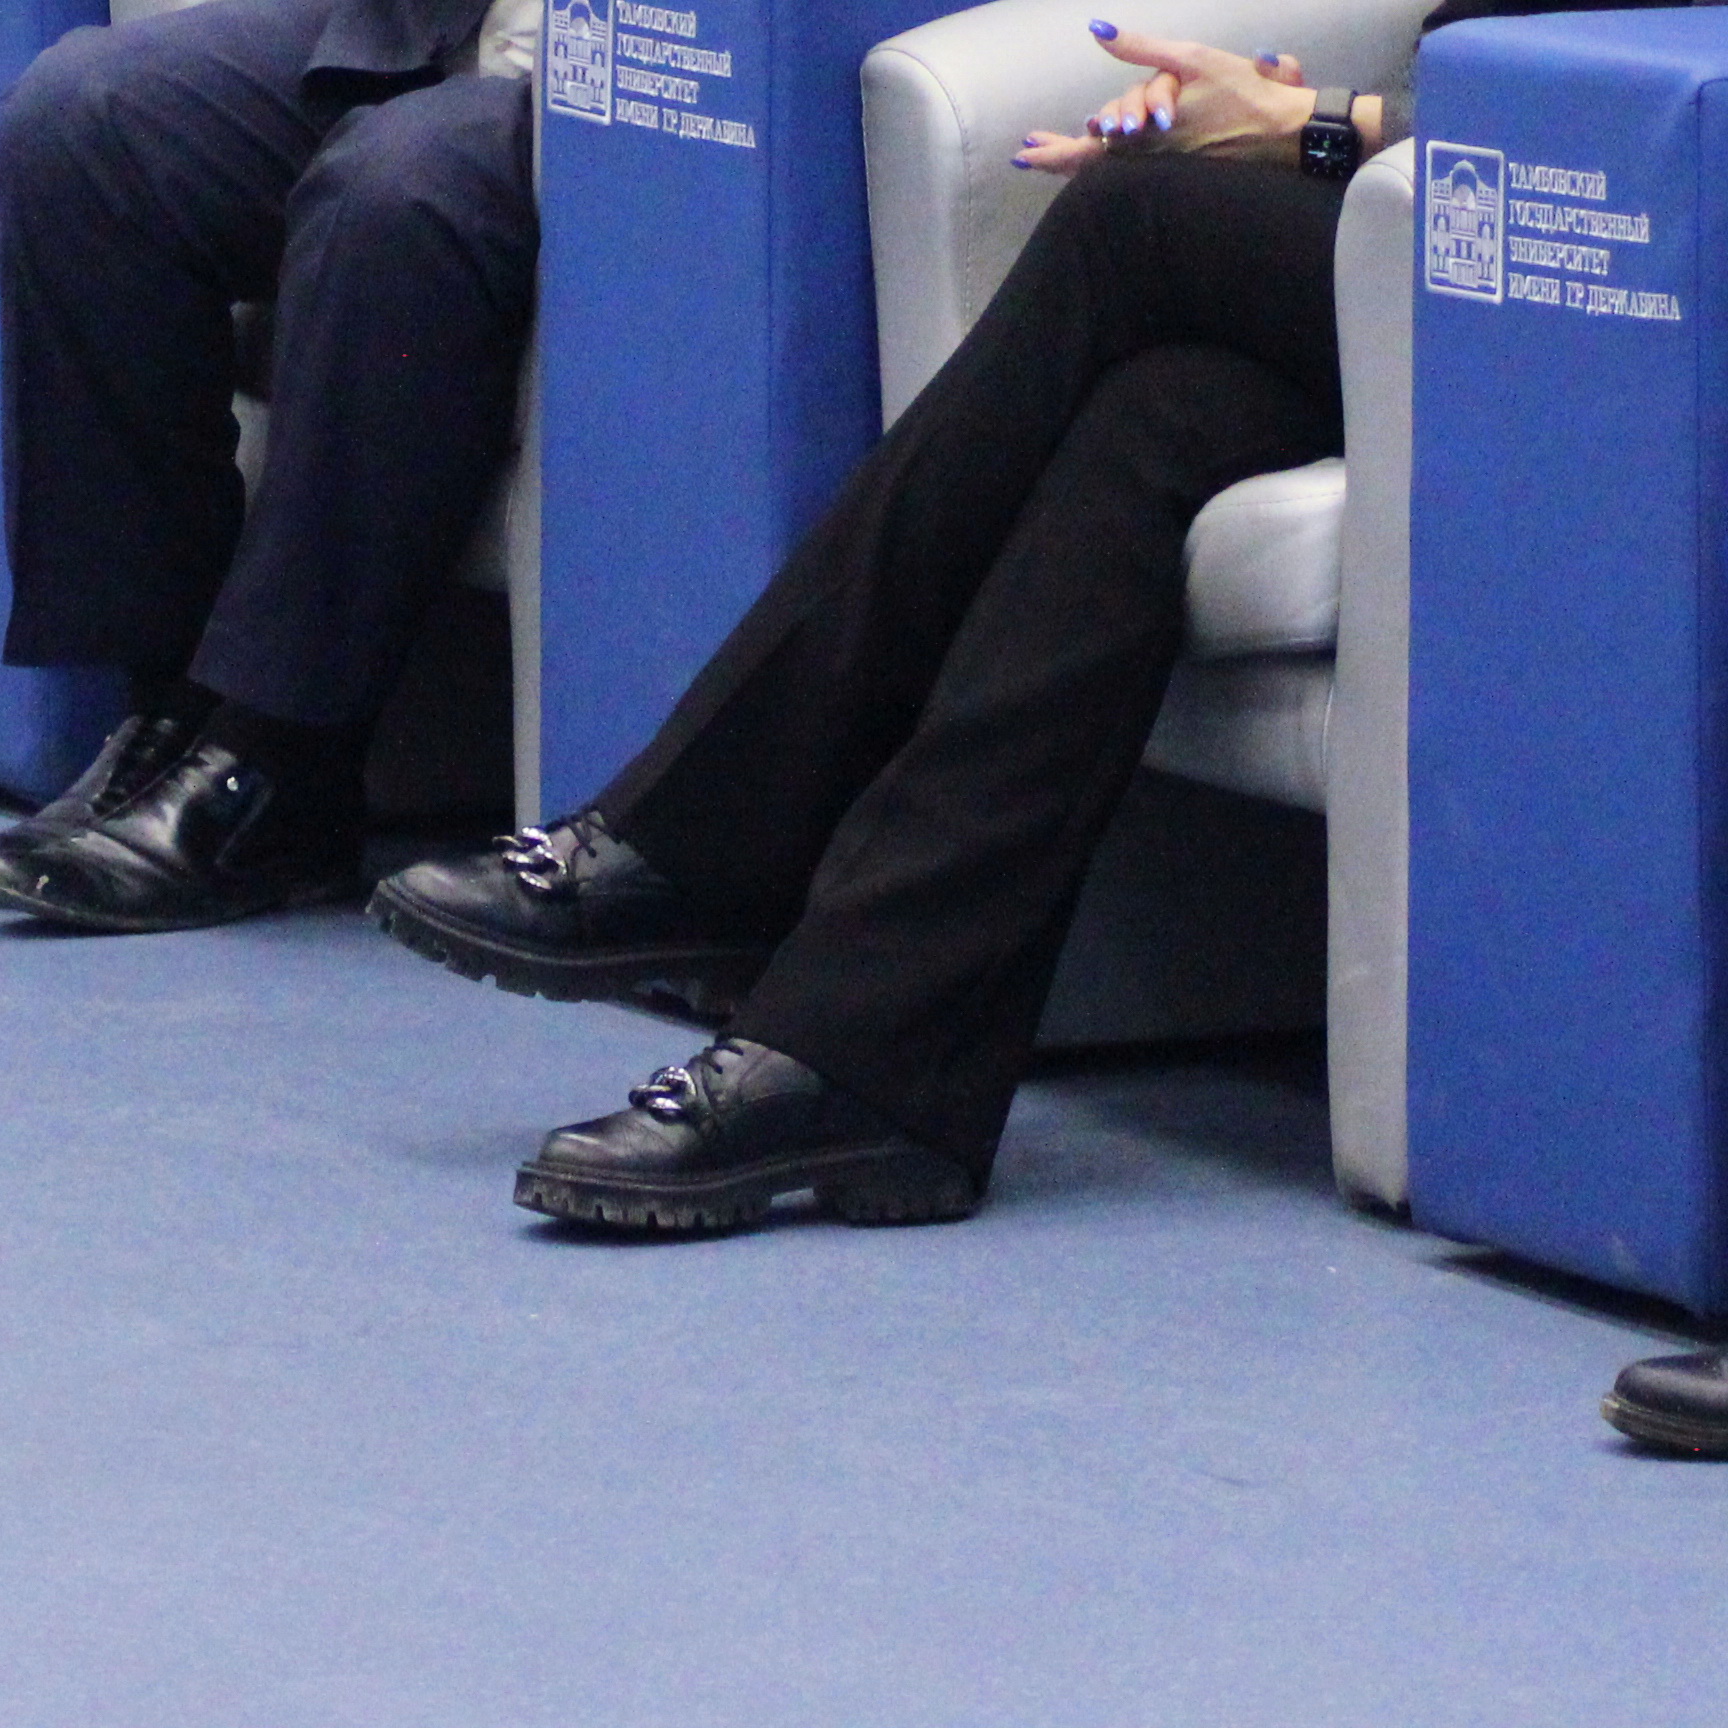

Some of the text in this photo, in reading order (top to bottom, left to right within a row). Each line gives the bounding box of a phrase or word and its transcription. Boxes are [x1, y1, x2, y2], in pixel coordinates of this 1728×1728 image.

[1508, 162, 1607, 201] ТАМБОВСКИЙ
[1509, 199, 1650, 244] ГОСУДАРСТВЕННЫЙ
[1508, 236, 1610, 276] УНИВЕРСИТЕТ
[1508, 272, 1560, 305] ИМЕНИ
[1585, 283, 1682, 321] ДЕРЖАВИНА
